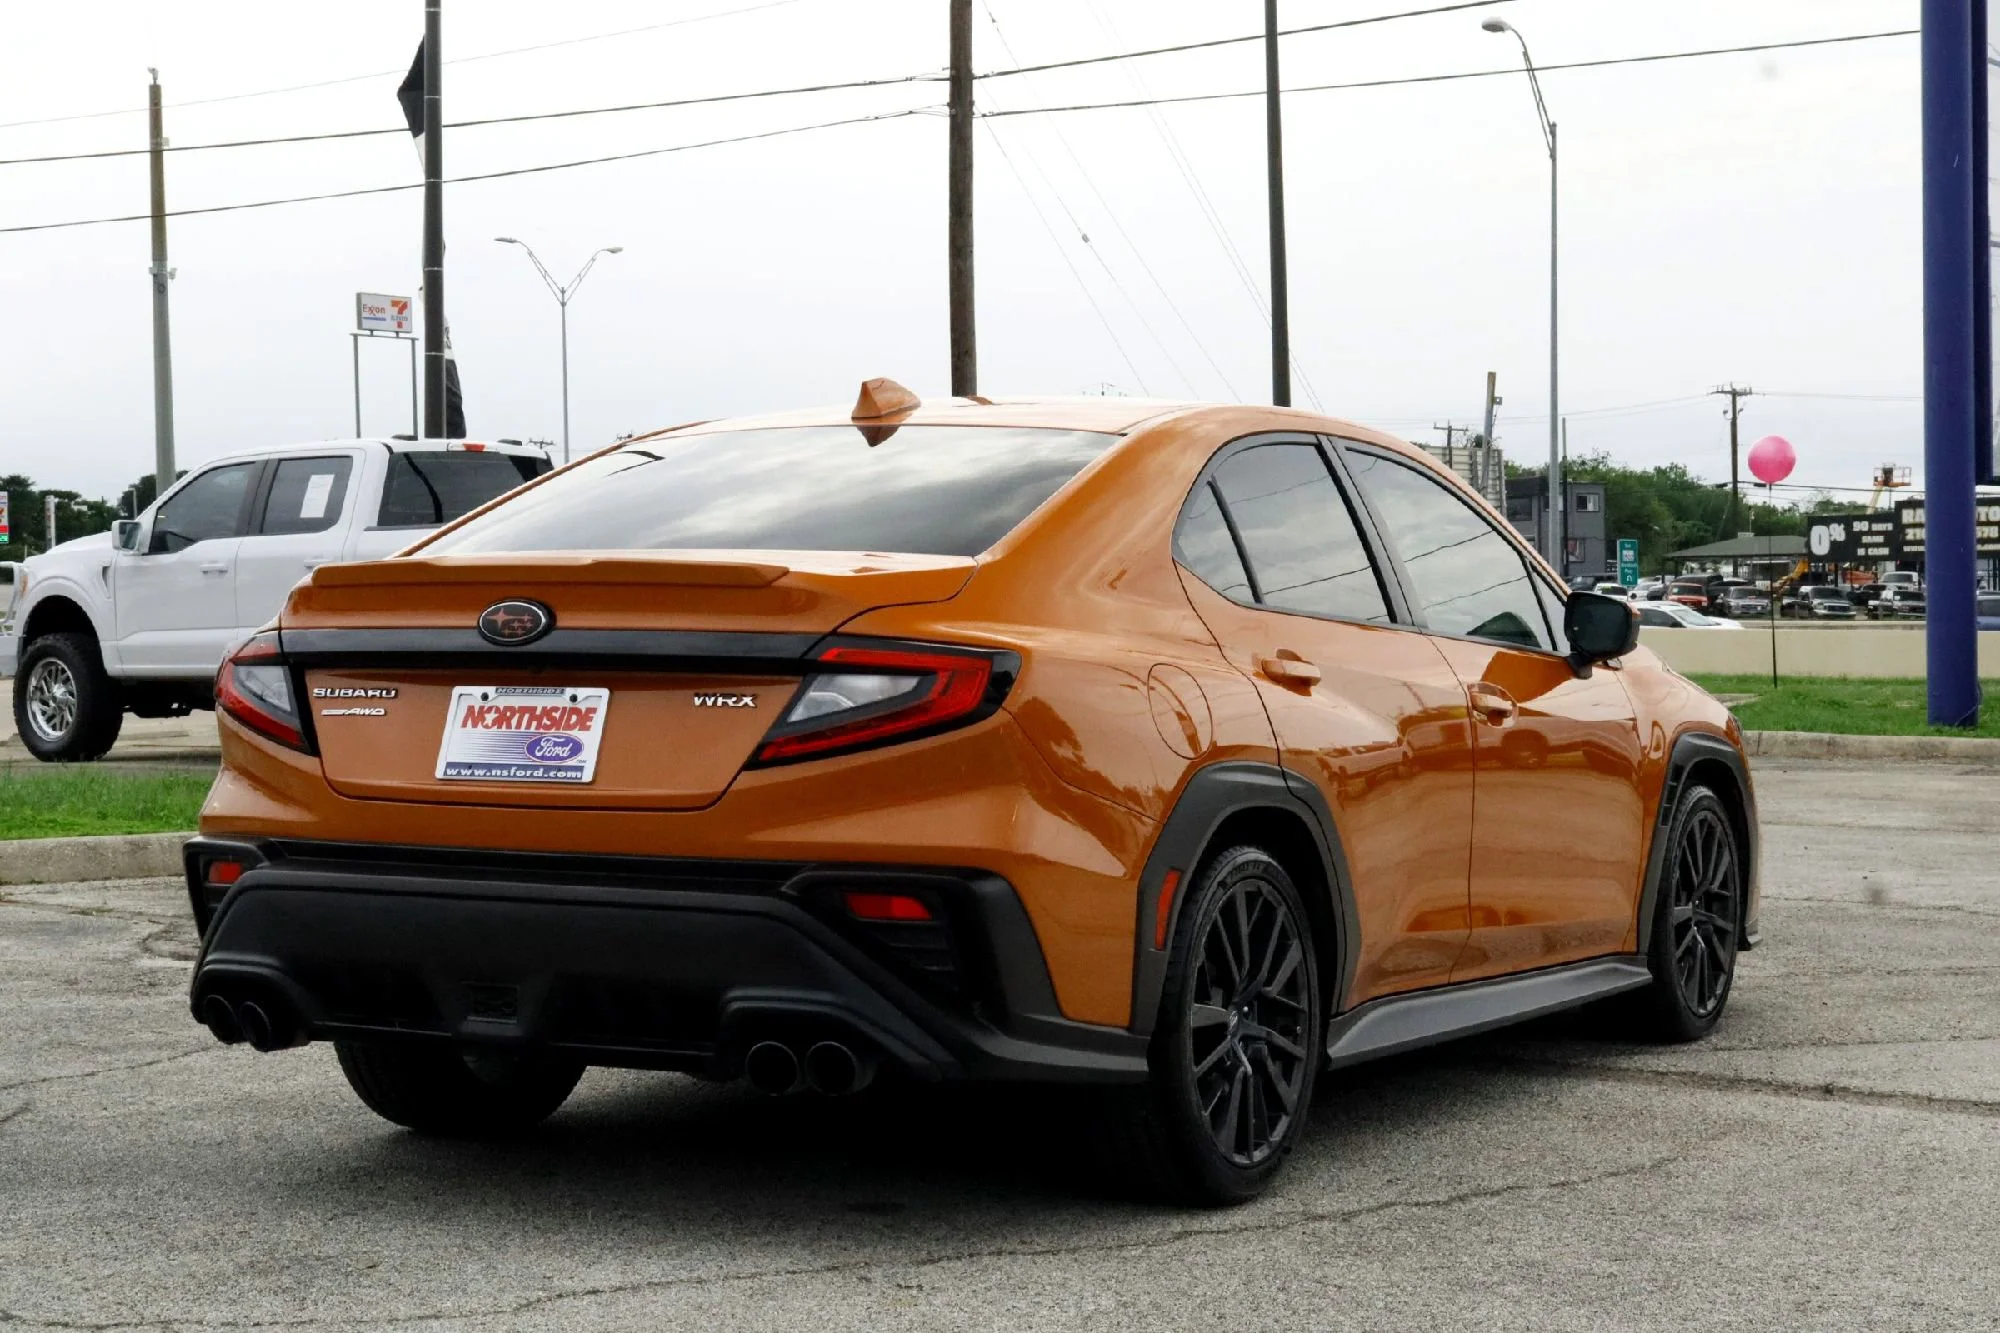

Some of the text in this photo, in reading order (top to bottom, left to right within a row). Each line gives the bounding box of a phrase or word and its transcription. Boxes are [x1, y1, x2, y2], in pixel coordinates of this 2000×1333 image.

[363, 304, 386, 316] Exxon
[1902, 505, 2000, 524] RA TO
[1810, 523, 1846, 556] 0%
[1868, 547, 1889, 555] CASH
[313, 688, 397, 698] SUBARU
[694, 693, 756, 707] WRX
[345, 707, 386, 716] AWD
[461, 705, 598, 732] NORTHSIDE
[535, 736, 573, 758] Ford
[446, 766, 582, 779] www.nsford.com
